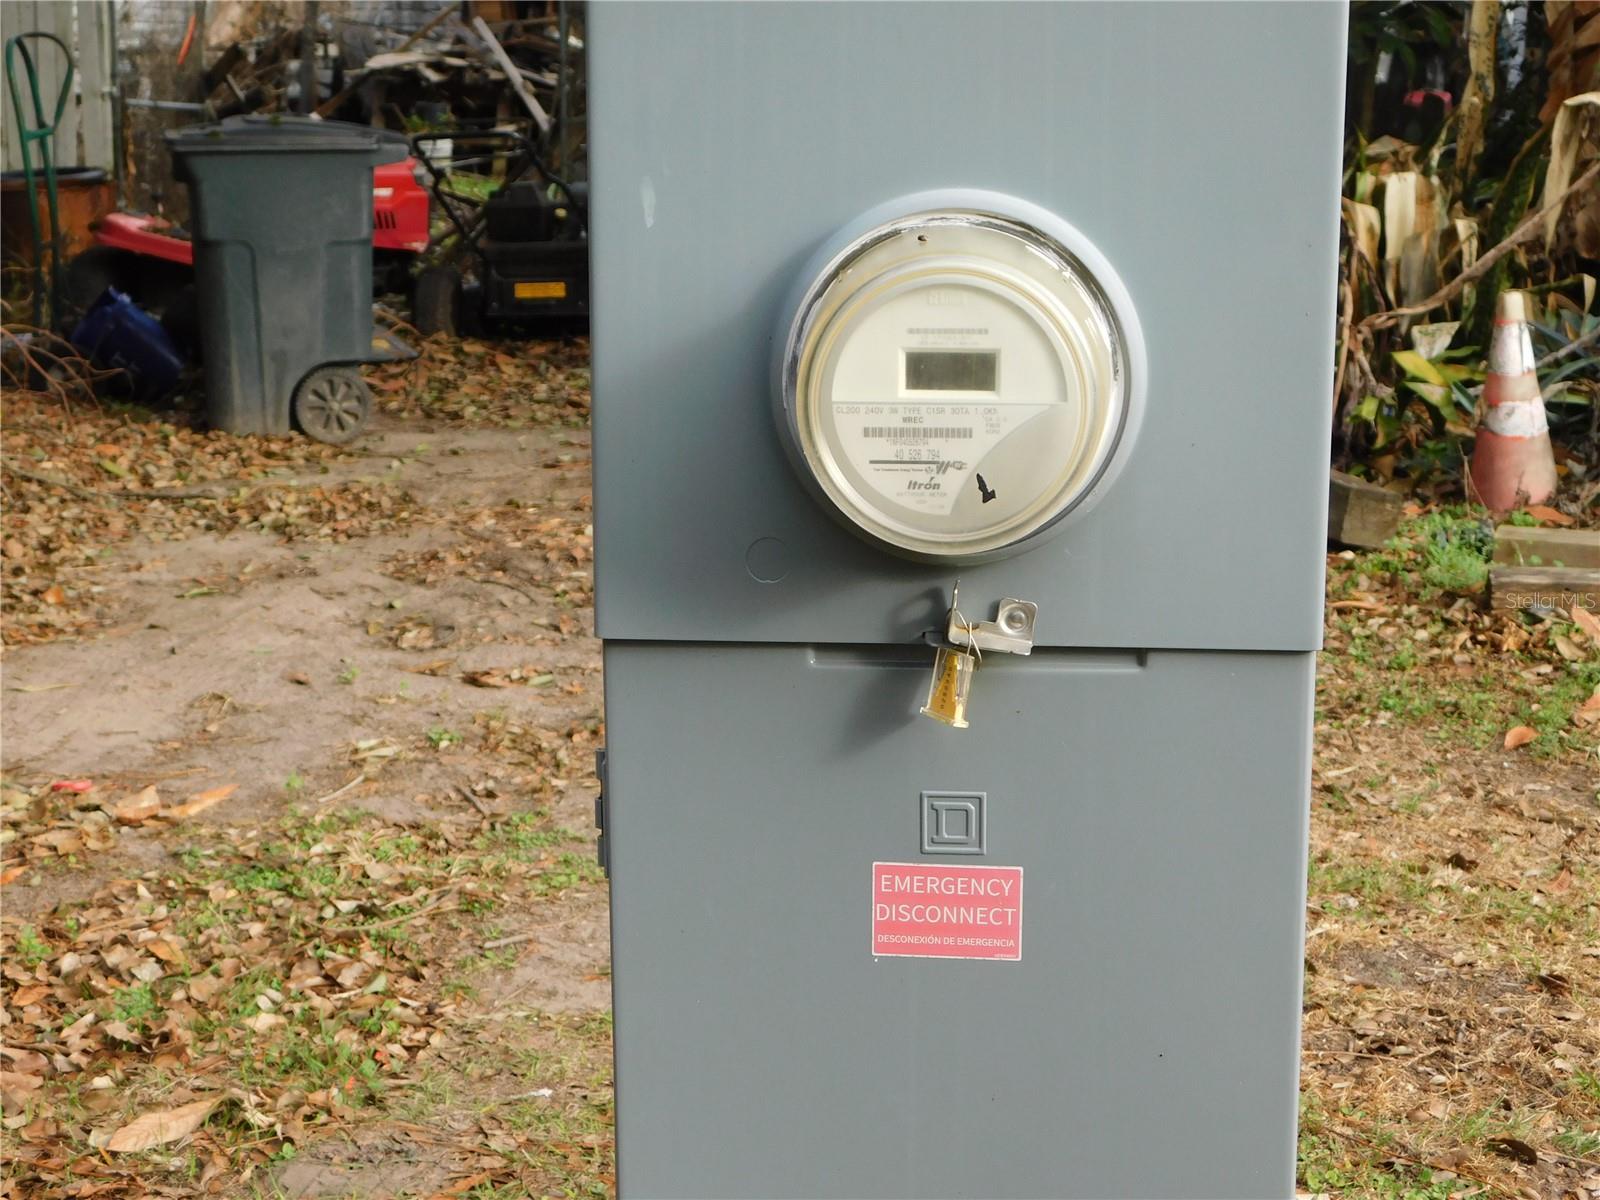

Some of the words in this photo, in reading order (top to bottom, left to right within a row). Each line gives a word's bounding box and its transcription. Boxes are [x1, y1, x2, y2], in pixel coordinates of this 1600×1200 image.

[903, 406, 921, 415] TYPE
[902, 416, 924, 424] WREC
[881, 874, 1013, 897] EMERGENCY
[876, 903, 1016, 926] DISCONNECT
[877, 933, 941, 945] DESCONEXIÓN
[943, 936, 955, 945] DE
[957, 936, 1015, 947] EMERGENCIA
